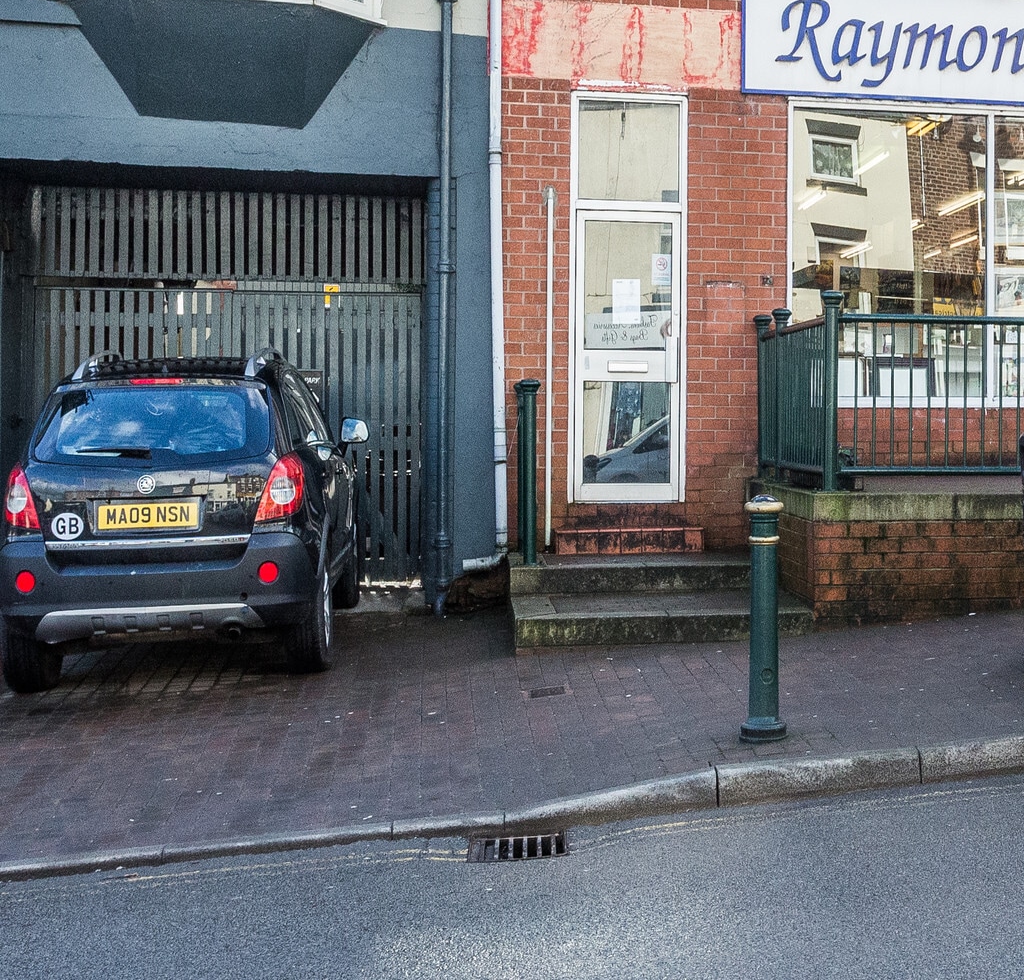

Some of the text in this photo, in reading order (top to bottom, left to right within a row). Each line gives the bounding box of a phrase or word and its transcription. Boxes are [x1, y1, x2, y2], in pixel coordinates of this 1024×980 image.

[106, 505, 190, 525] MA09 NSN
[56, 517, 79, 534] GB
